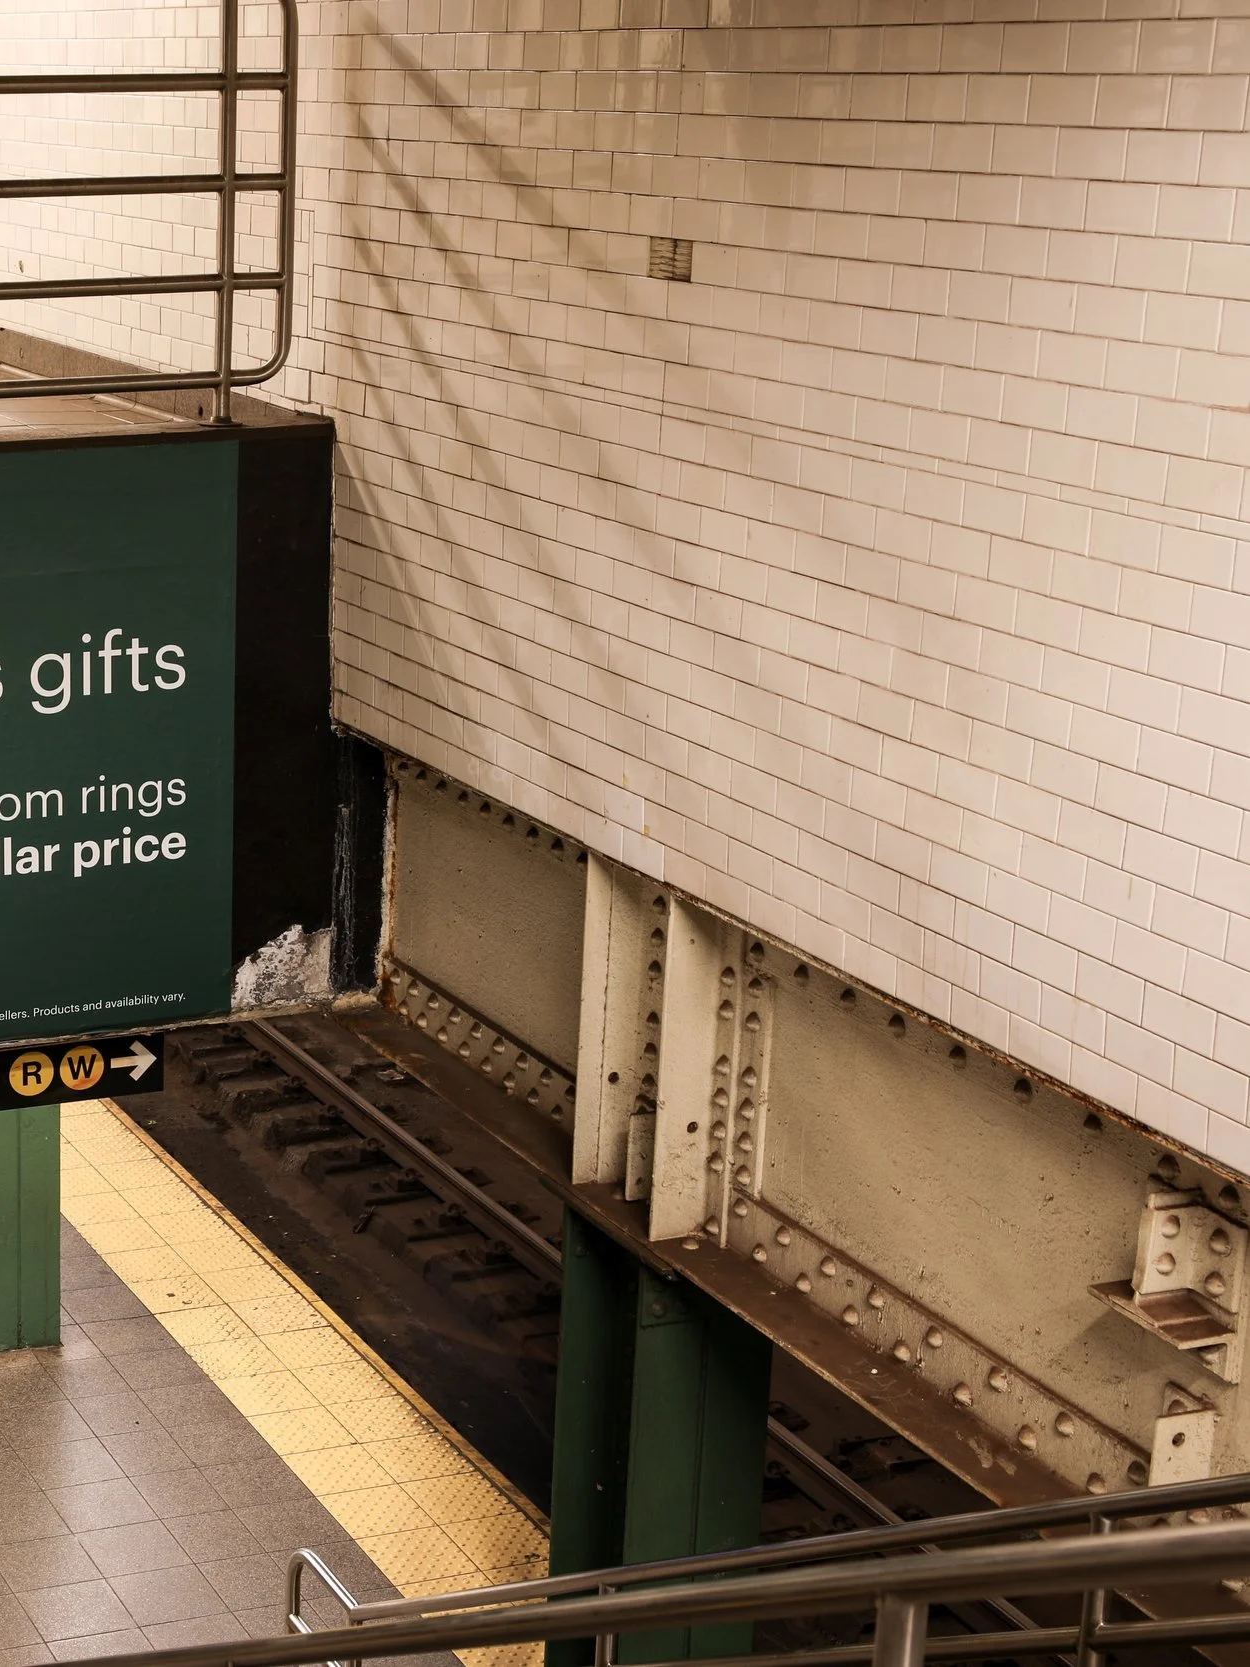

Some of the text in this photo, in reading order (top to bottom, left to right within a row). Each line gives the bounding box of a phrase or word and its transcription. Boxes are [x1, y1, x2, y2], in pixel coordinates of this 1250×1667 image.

[30, 628, 186, 714] gifts
[81, 775, 186, 817] rings
[74, 826, 187, 877] price
[33, 1003, 80, 1017] Products
[82, 1000, 102, 1012] and
[105, 994, 159, 1009] availability
[161, 993, 186, 1004] vary.
[22, 1053, 97, 1086] R W
